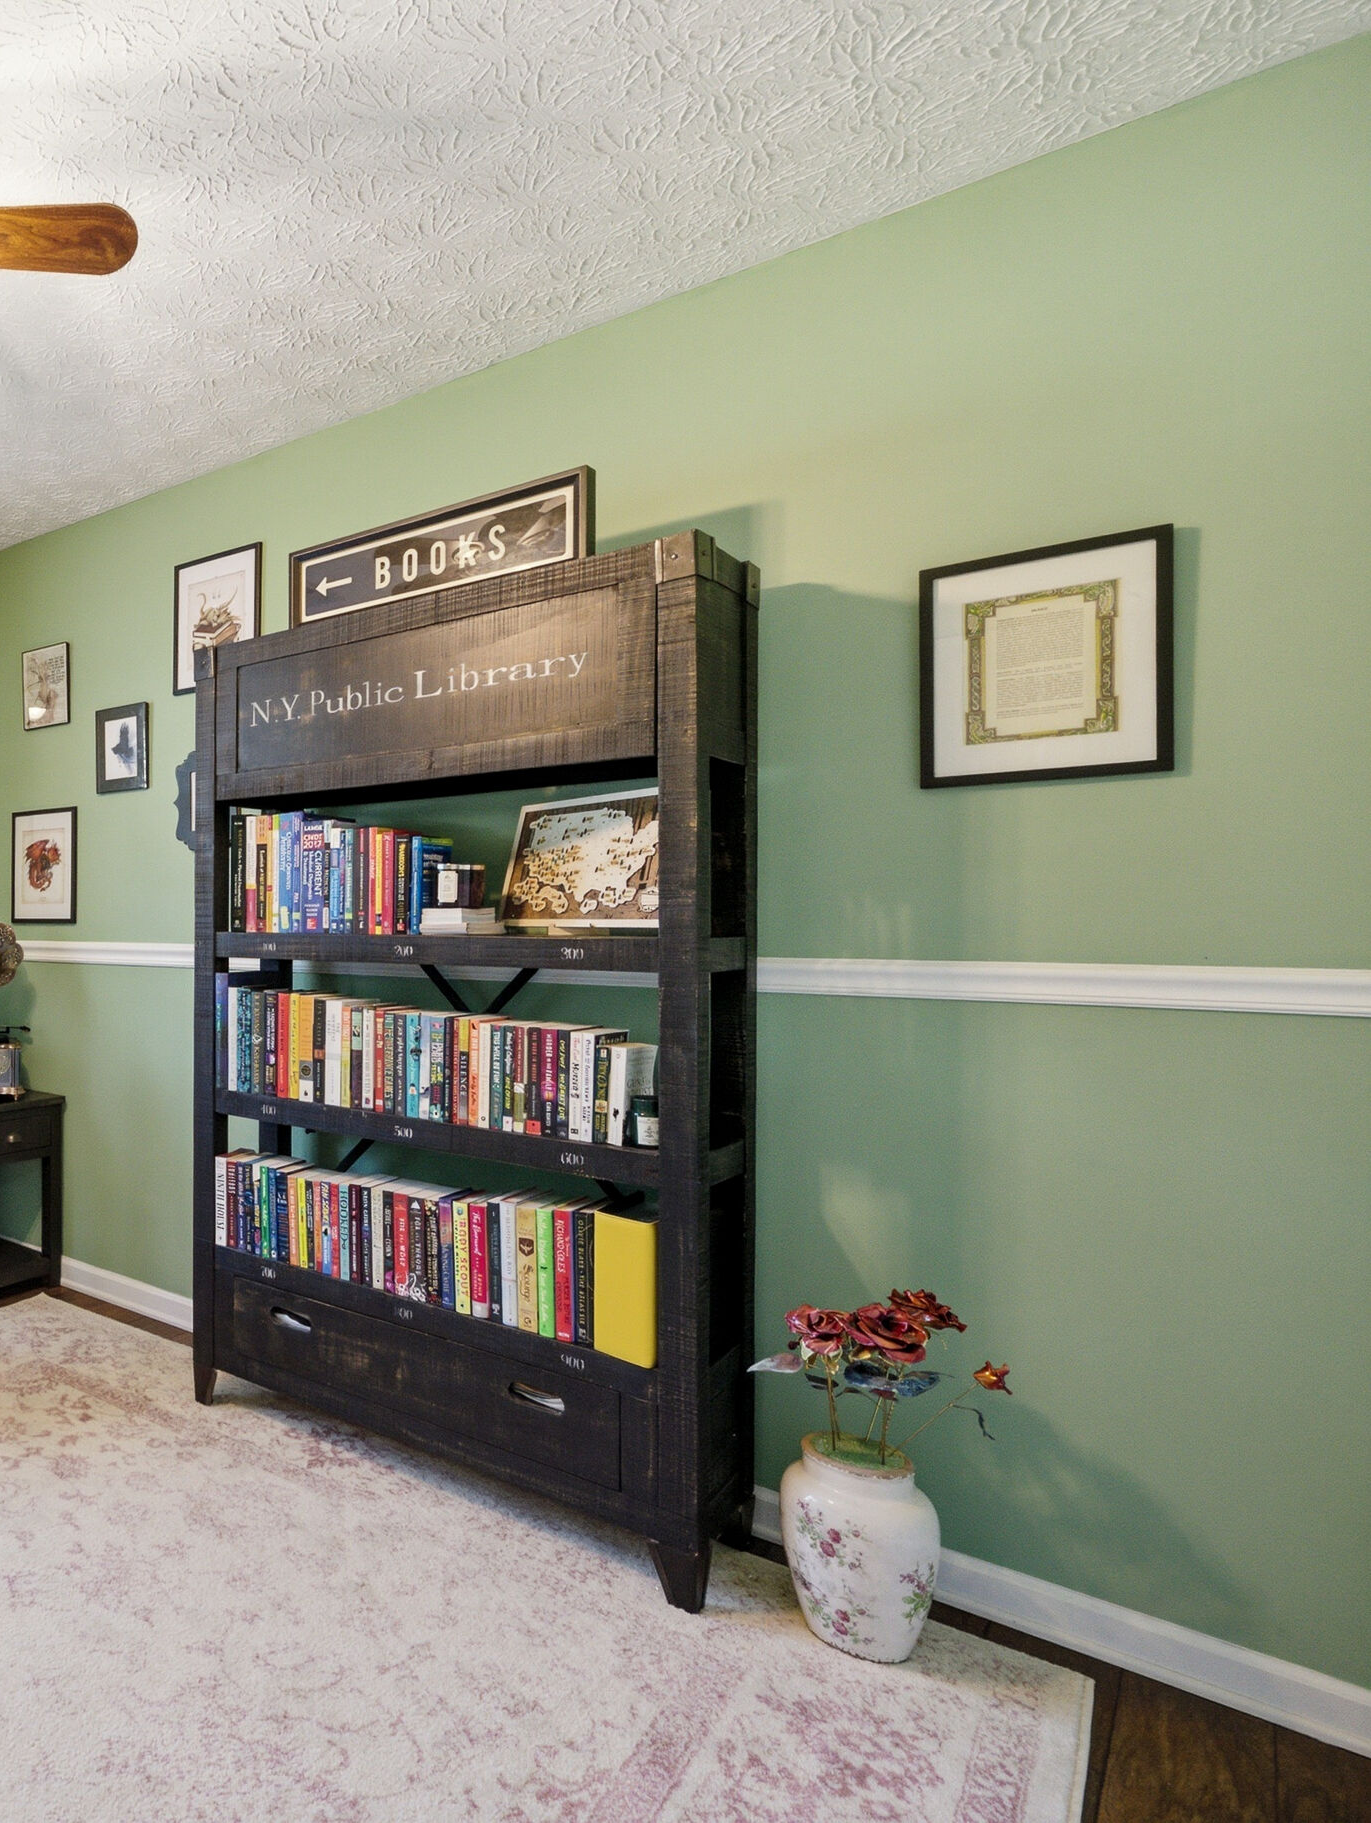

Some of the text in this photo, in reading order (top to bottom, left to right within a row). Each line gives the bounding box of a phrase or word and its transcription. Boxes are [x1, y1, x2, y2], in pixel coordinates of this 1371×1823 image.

[374, 524, 508, 591] BOOKS
[310, 680, 405, 717] Public
[414, 651, 589, 700] Library
[394, 945, 413, 956] 200
[560, 947, 584, 960] 300
[393, 1126, 414, 1139] 500
[560, 1152, 584, 1166] 600
[459, 1257, 468, 1296] SCOUT
[560, 1353, 584, 1370] 900
